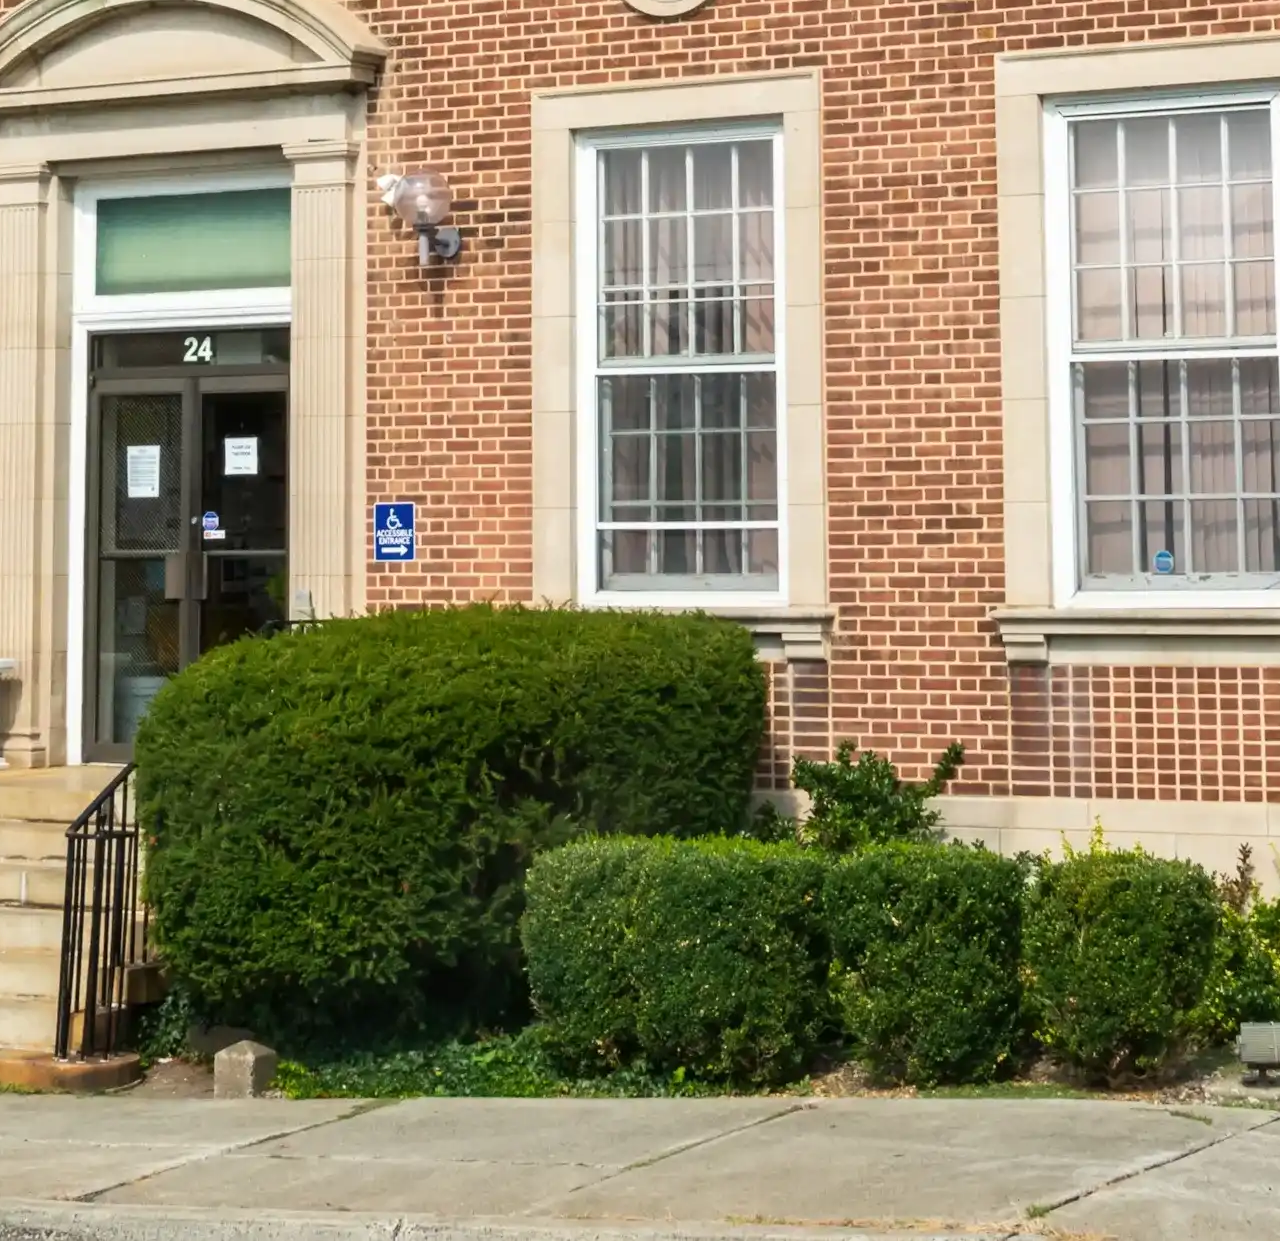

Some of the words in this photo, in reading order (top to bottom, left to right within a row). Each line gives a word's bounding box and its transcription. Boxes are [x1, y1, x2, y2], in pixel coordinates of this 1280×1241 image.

[183, 336, 213, 362] 24
[376, 528, 413, 538] ACCESSIBLE
[378, 536, 411, 545] ENTRANCE
